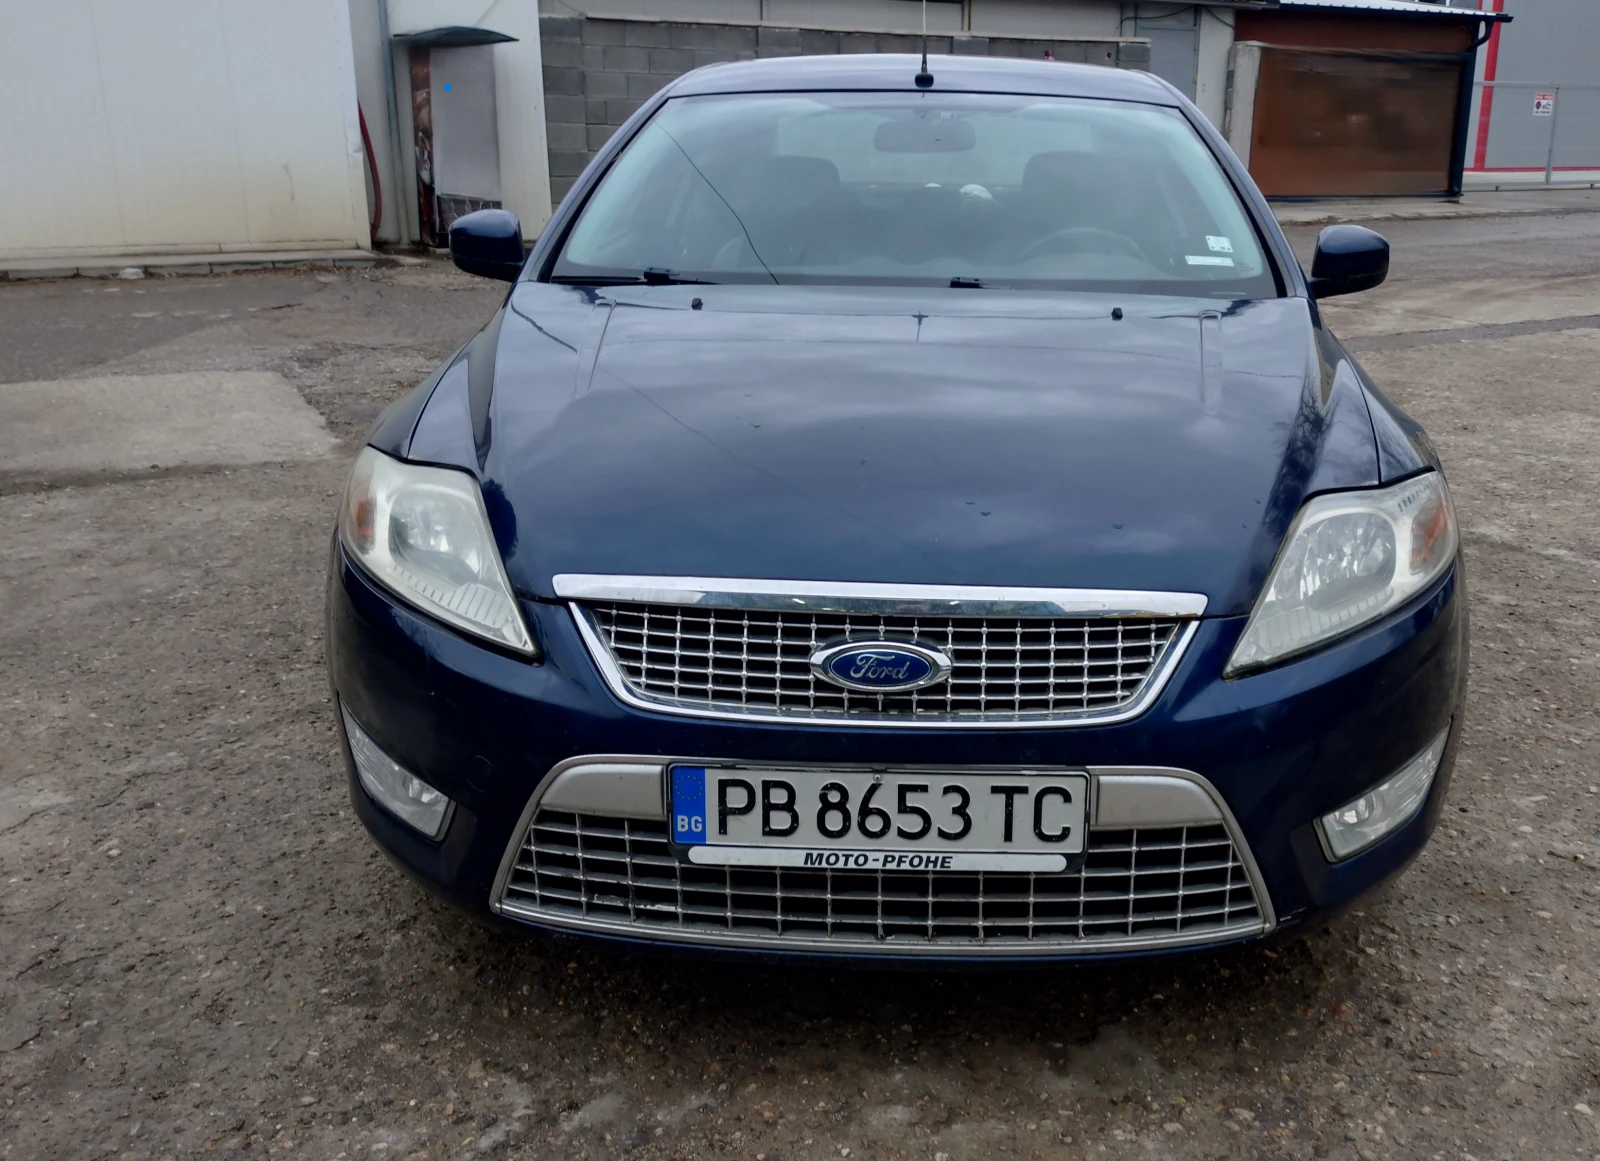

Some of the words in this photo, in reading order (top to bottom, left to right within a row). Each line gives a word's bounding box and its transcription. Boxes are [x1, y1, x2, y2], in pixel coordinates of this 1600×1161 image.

[850, 653, 910, 679] Ford
[717, 778, 800, 838] PB
[816, 782, 973, 841] 8653
[990, 785, 1072, 843] TC
[677, 814, 703, 832] BG
[803, 852, 953, 869] MOTO-PFOHE
